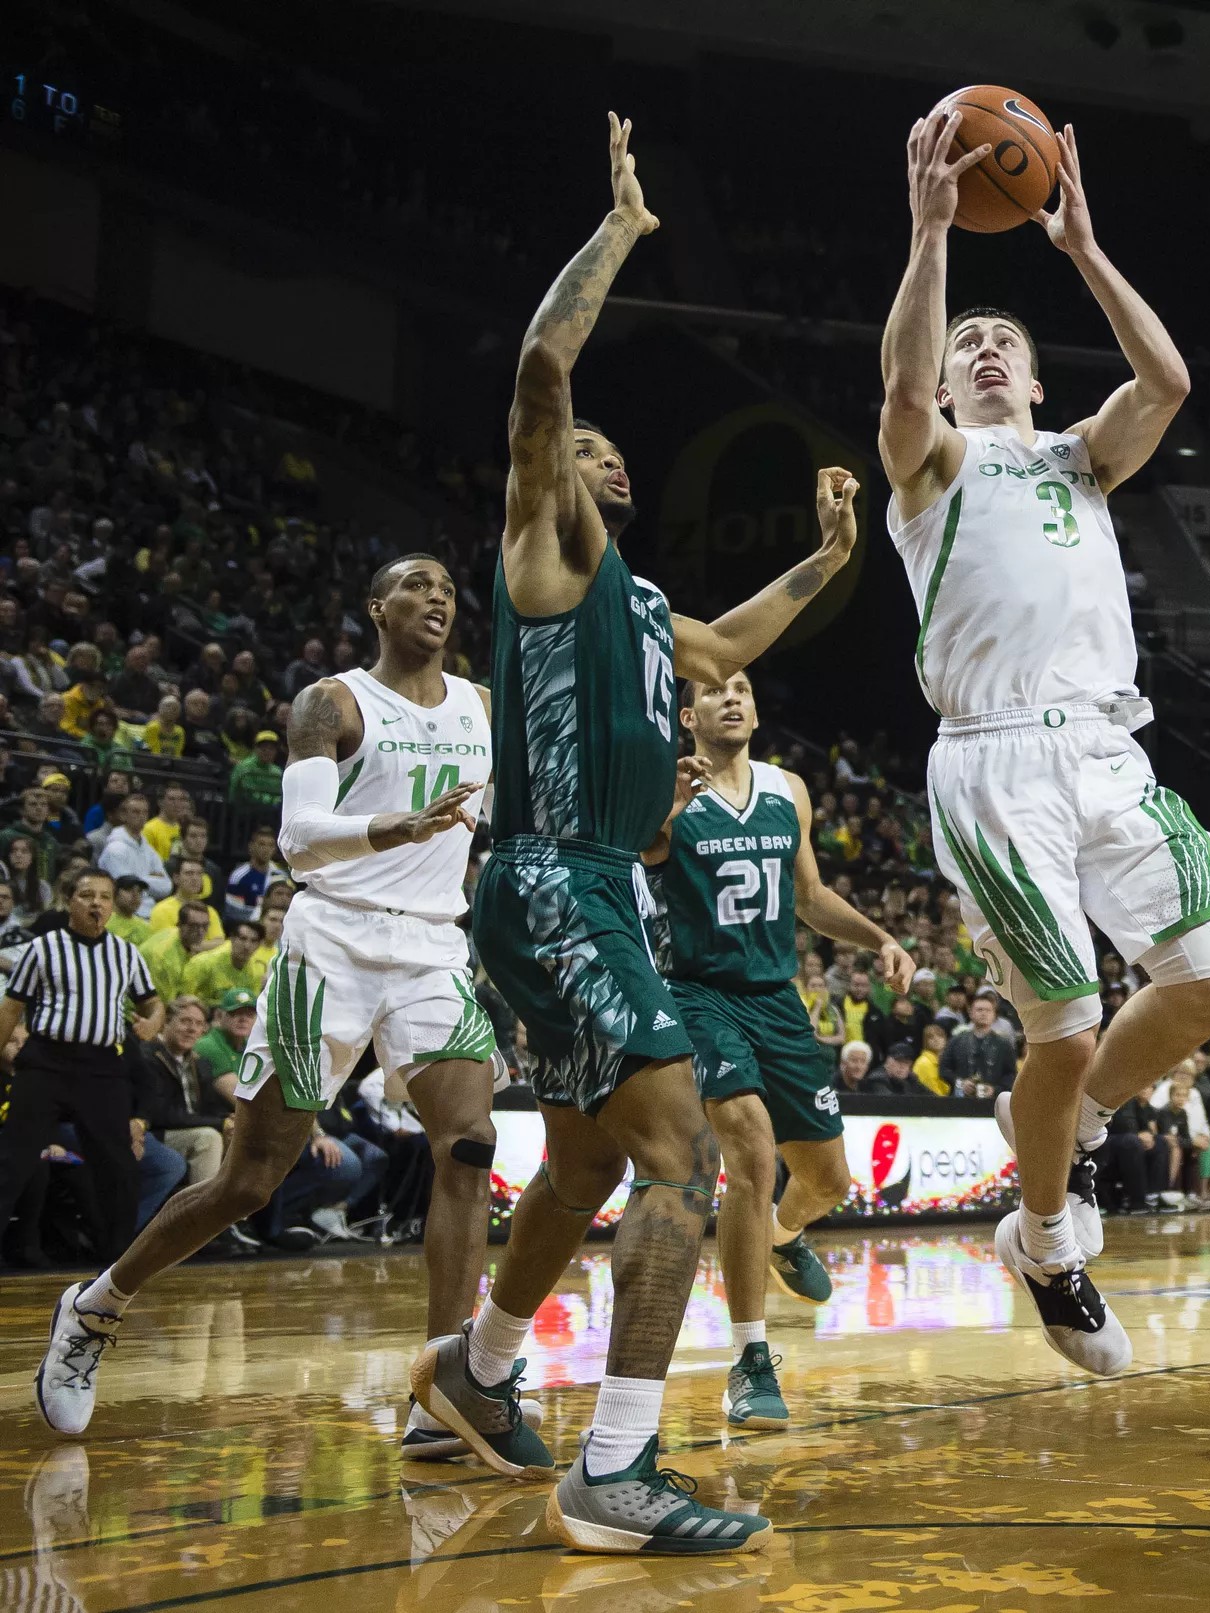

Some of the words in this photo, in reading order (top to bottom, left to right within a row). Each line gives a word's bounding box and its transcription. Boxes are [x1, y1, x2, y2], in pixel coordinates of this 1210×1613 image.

[1035, 480, 1081, 548] 3
[407, 763, 460, 812] 14
[696, 836, 758, 856] GREEN
[760, 835, 793, 851] BAY
[715, 857, 782, 926] 21
[919, 1143, 982, 1188] pepsi
